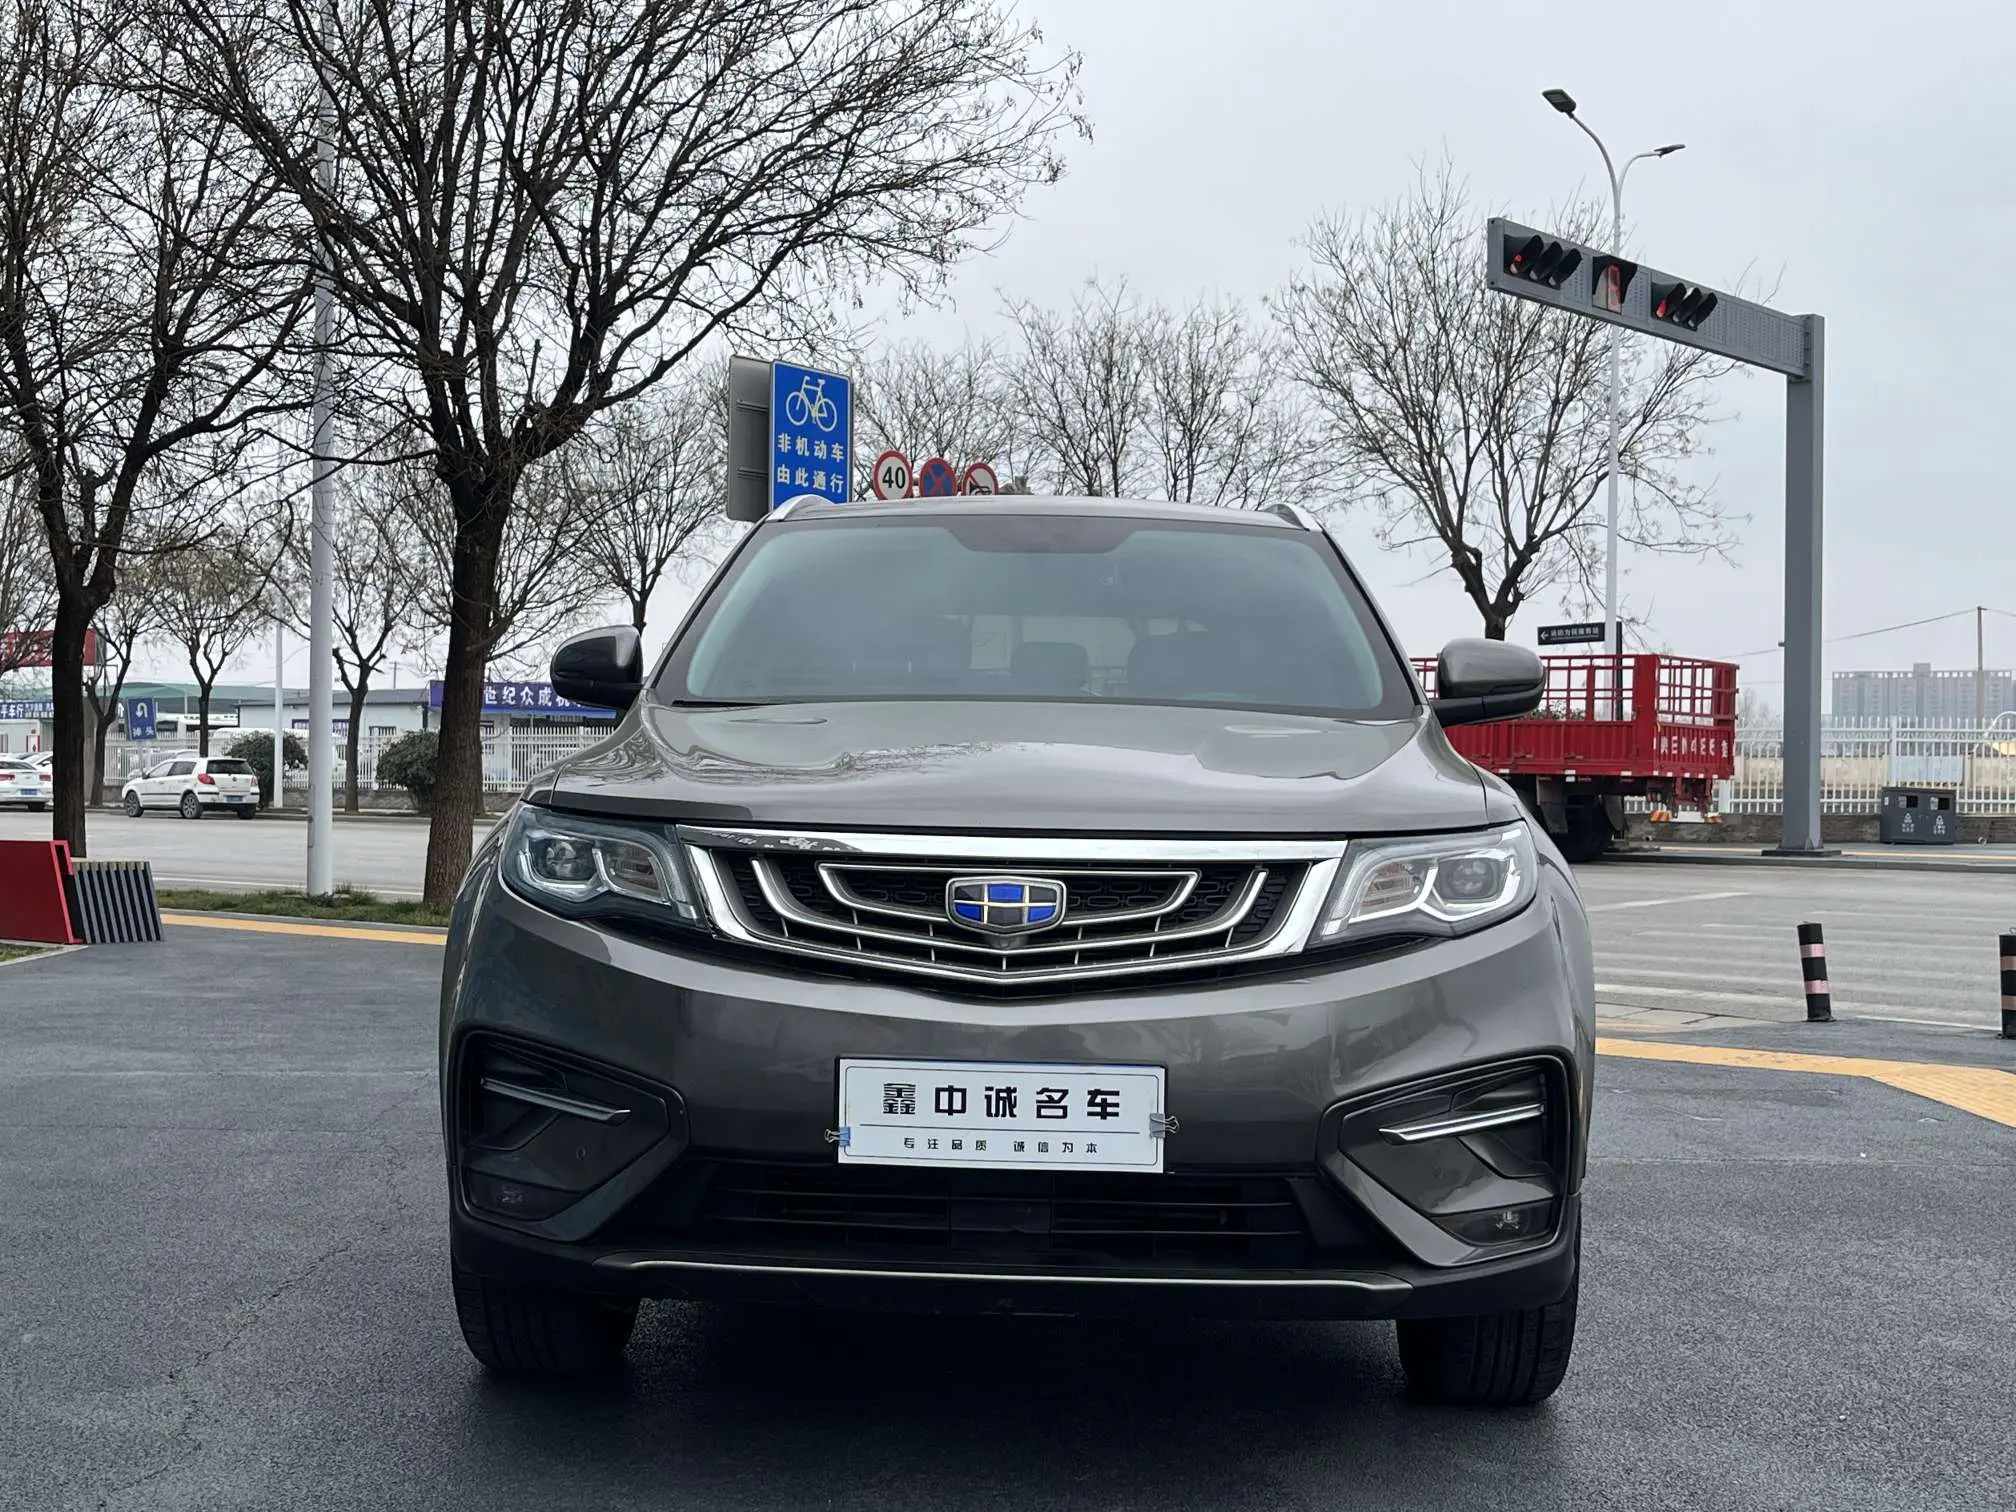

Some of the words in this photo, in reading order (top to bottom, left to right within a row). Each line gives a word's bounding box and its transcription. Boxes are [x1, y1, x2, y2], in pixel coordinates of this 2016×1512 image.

[777, 433, 844, 463] 非机动车
[776, 464, 844, 493] 由此通行
[882, 466, 906, 489] 40
[882, 1082, 1121, 1121] 鑫中诚名车
[903, 1136, 988, 1152] 专注品质
[1013, 1140, 1098, 1154] 诚信为本
